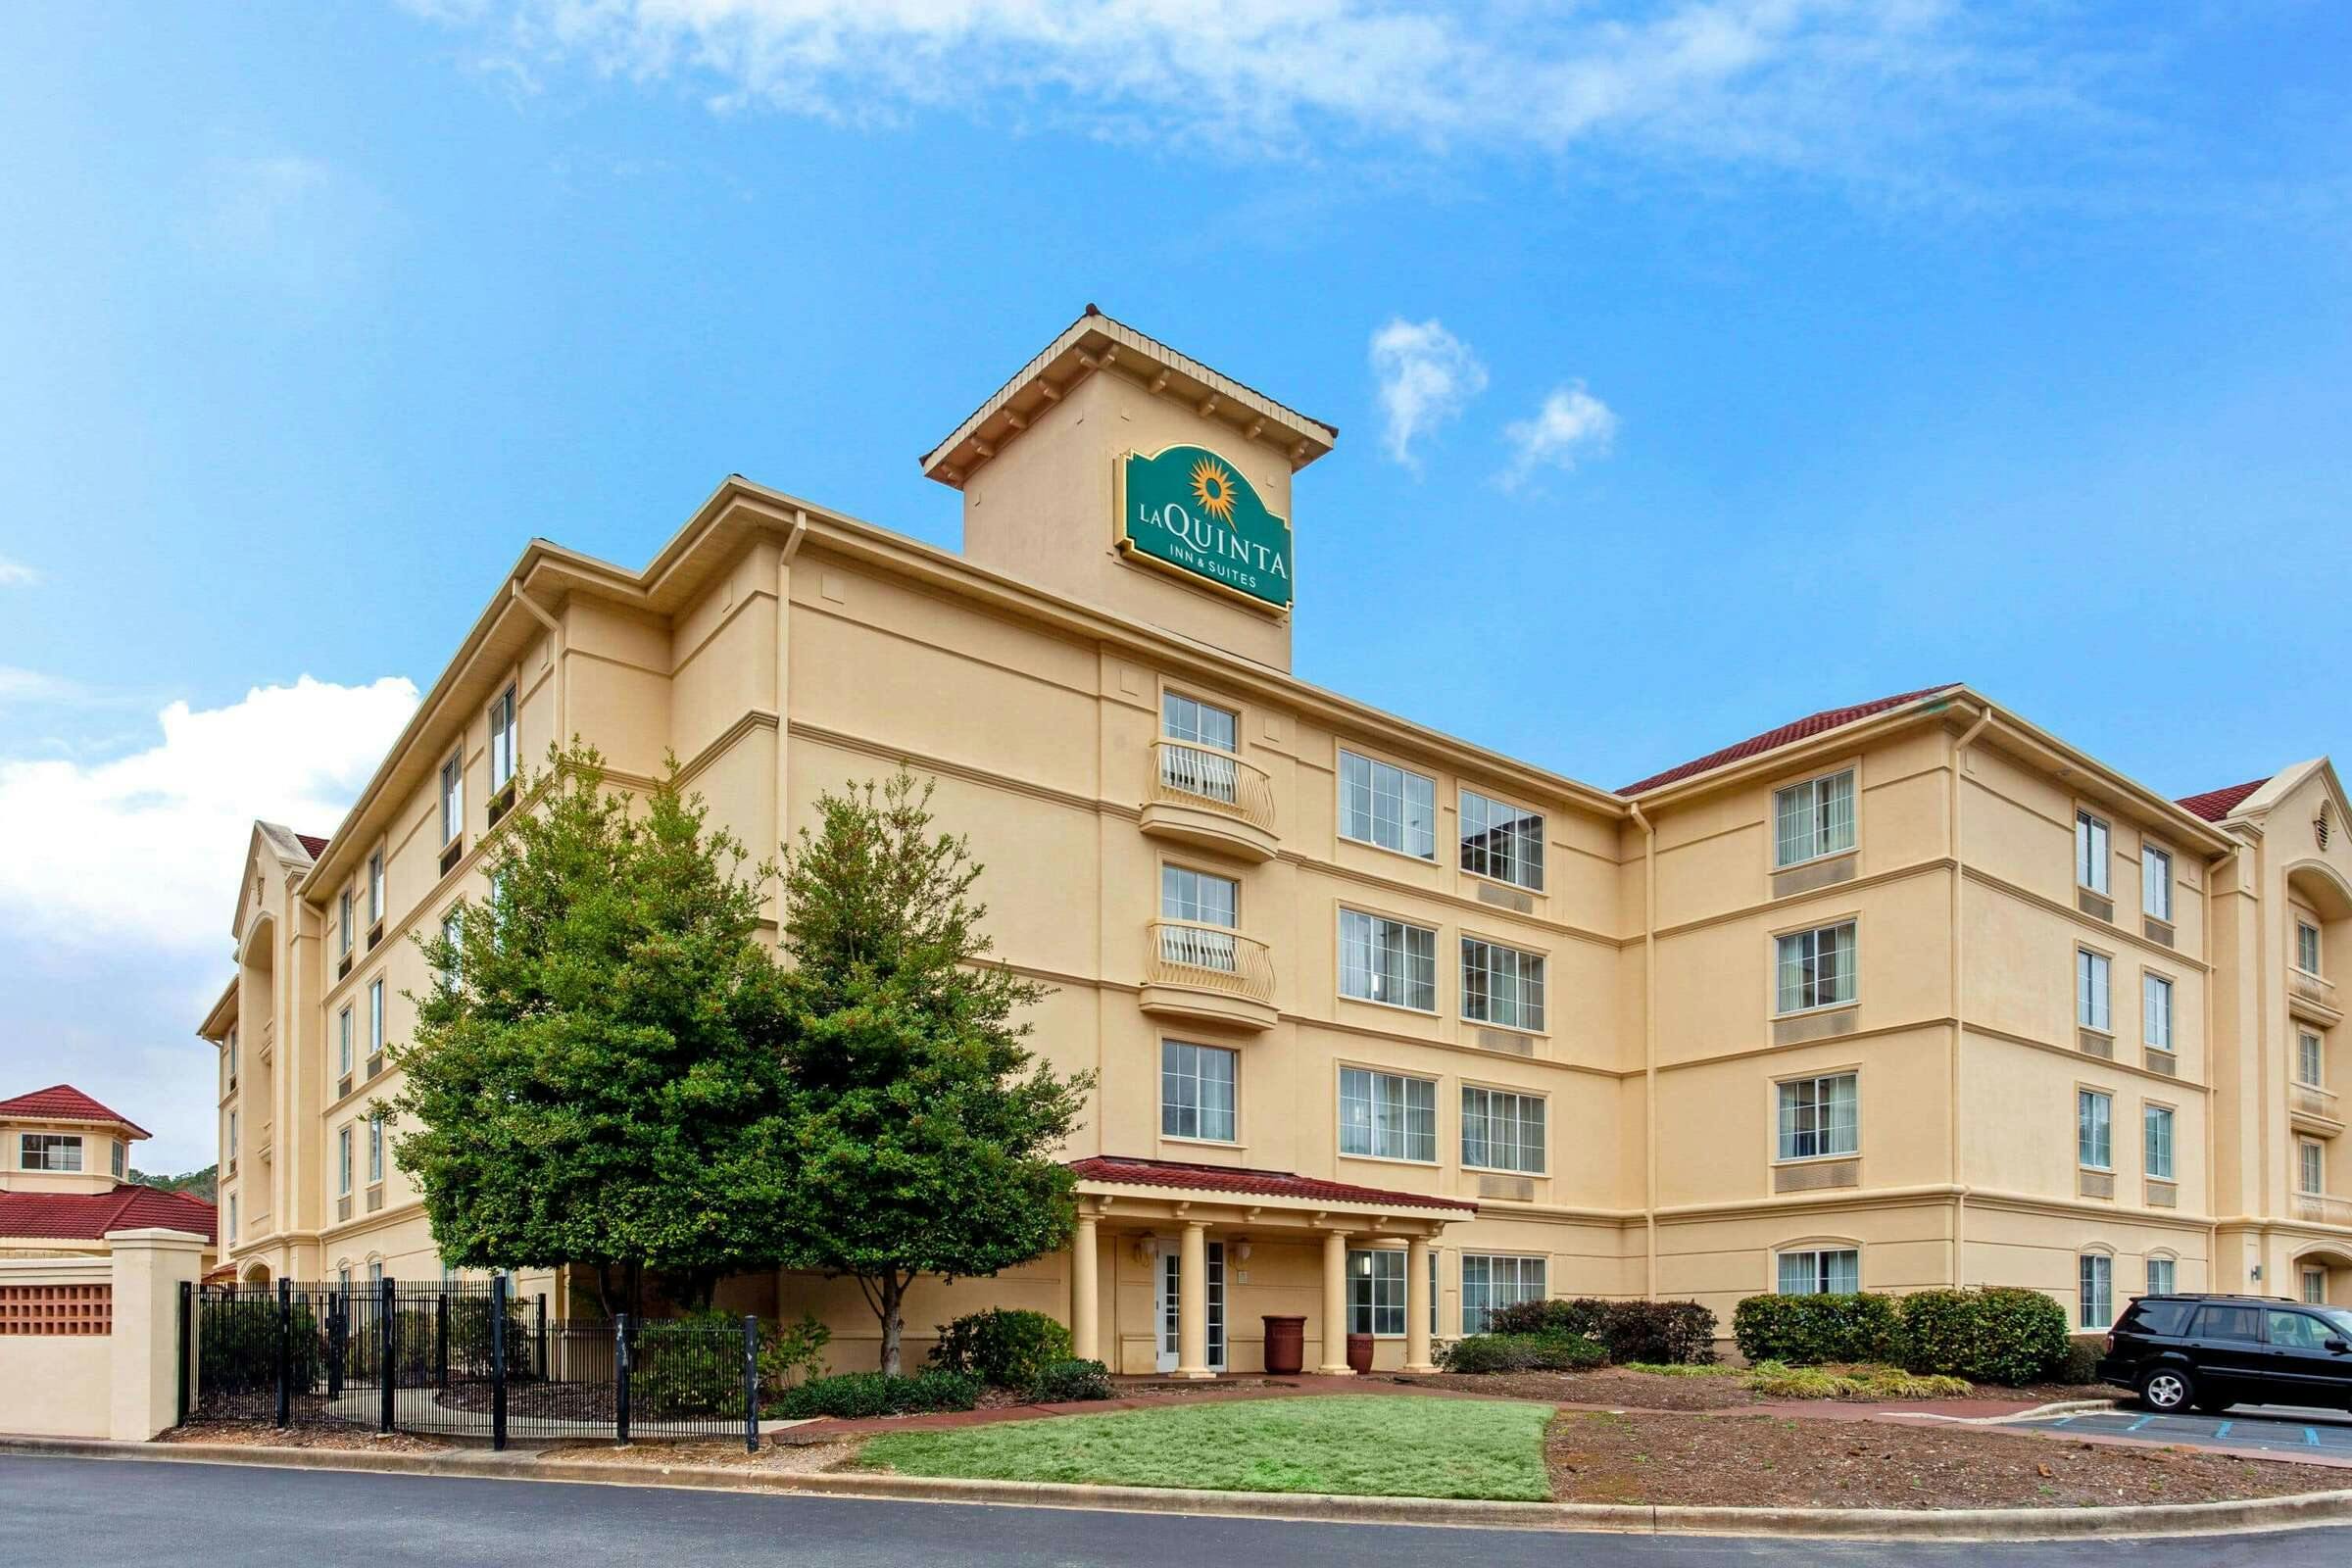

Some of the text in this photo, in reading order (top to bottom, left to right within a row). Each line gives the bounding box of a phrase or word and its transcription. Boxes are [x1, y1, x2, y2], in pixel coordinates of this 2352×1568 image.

[1139, 503, 1288, 580] LA QUINTA
[1169, 543, 1256, 588] INN & SUITES
